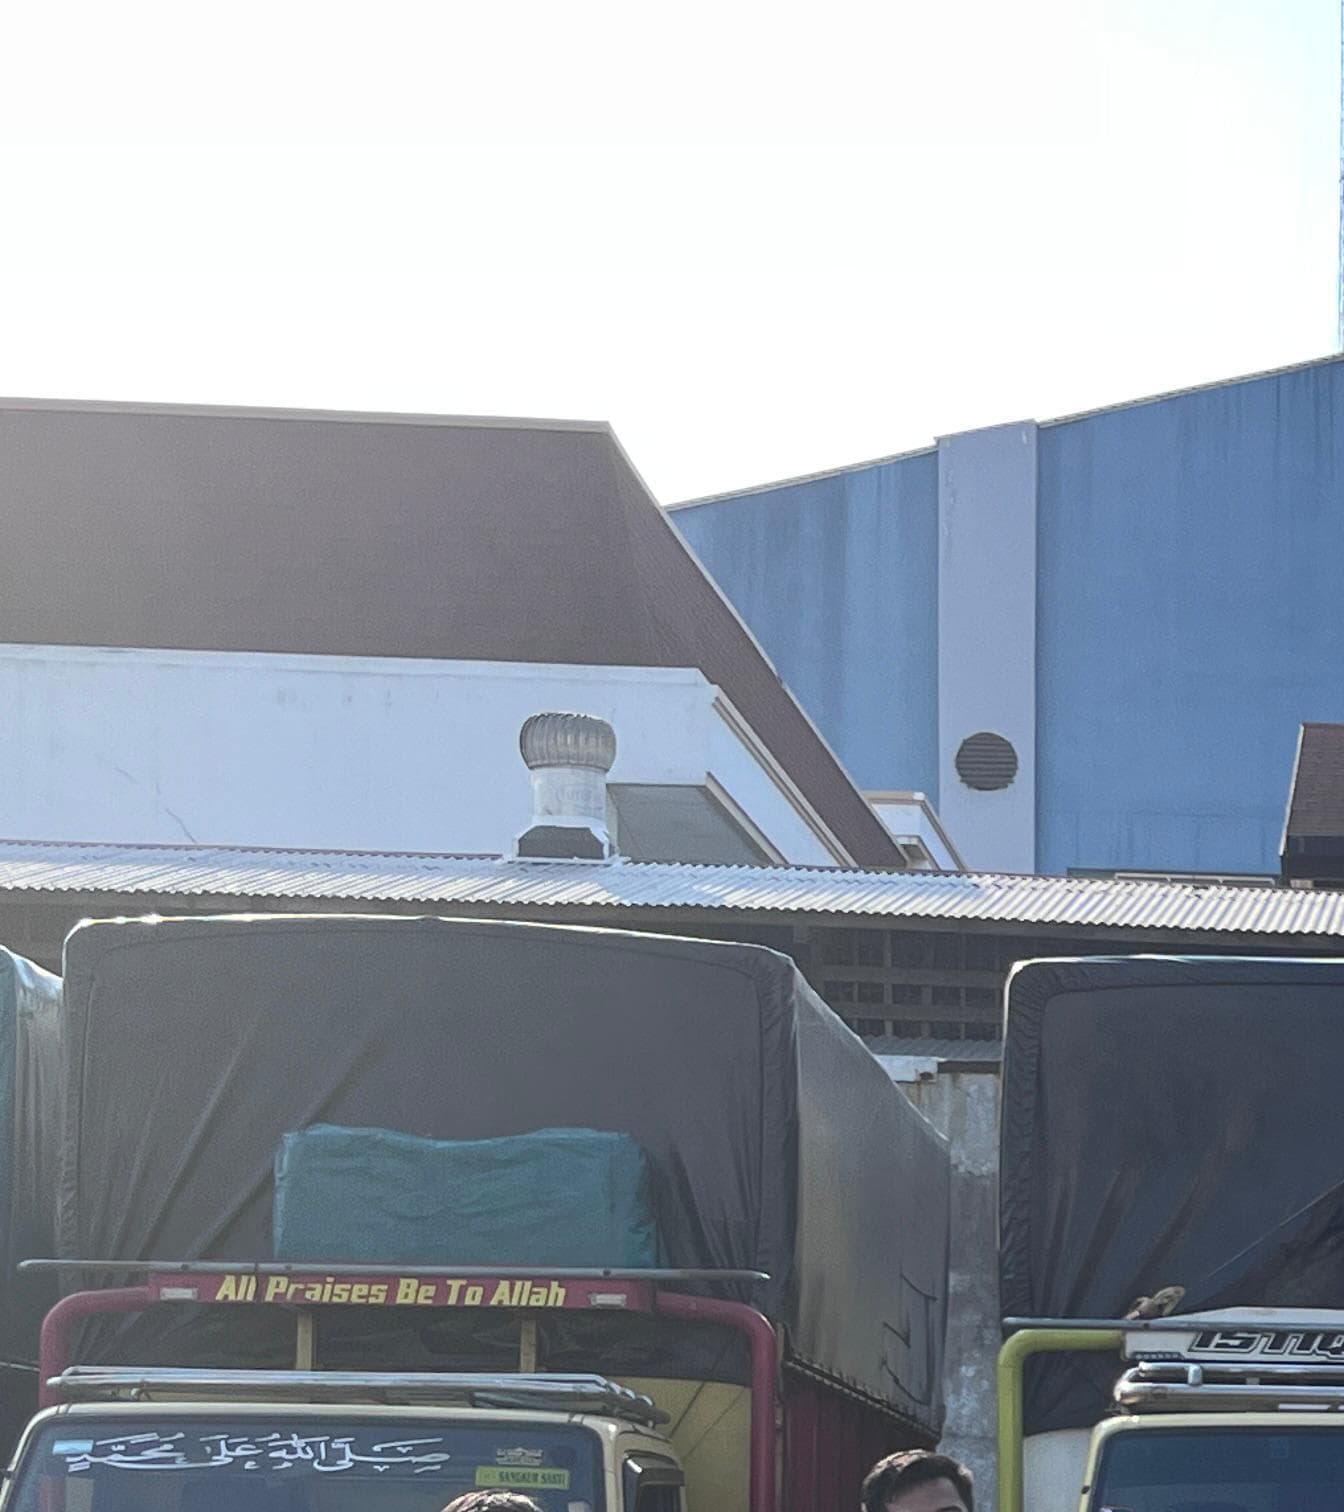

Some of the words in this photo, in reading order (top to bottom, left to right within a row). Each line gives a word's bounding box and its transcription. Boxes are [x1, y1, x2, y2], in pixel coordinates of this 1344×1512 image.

[214, 1275, 257, 1301] All
[265, 1276, 388, 1303] Praises
[396, 1278, 437, 1305] Be
[446, 1279, 484, 1306] To
[490, 1280, 566, 1307] Allah
